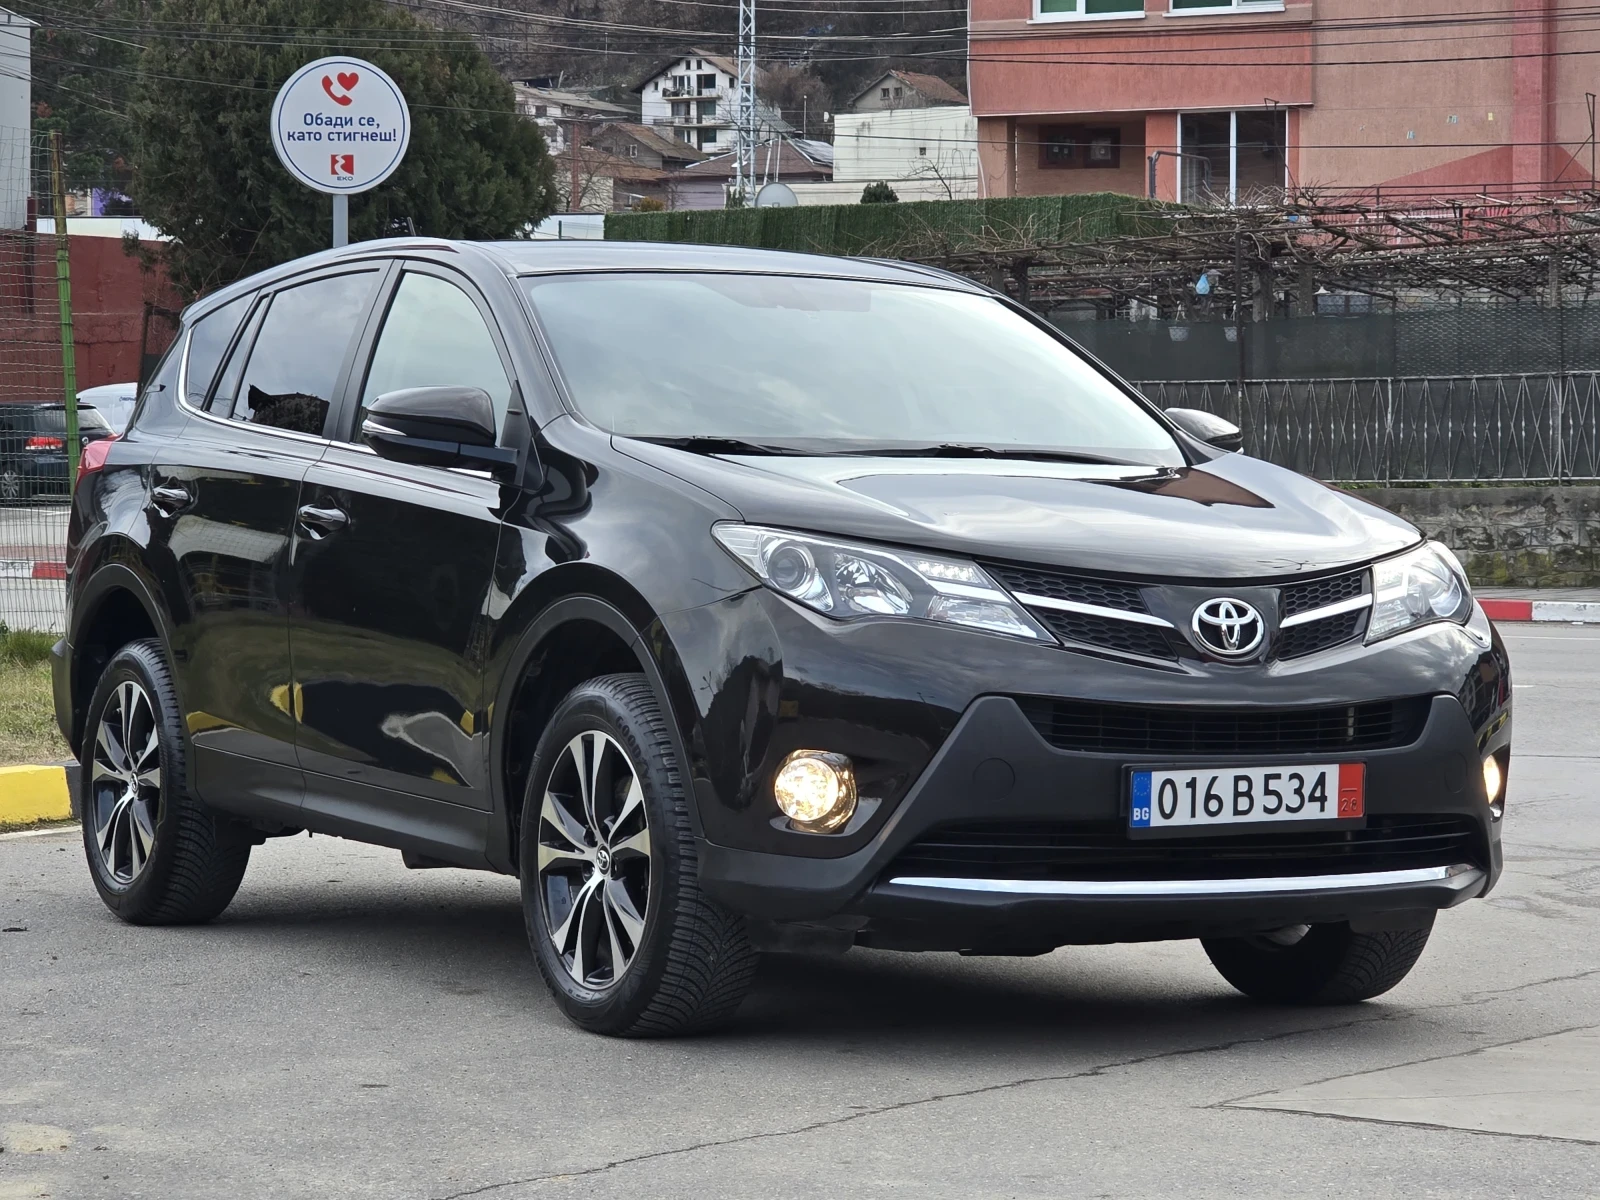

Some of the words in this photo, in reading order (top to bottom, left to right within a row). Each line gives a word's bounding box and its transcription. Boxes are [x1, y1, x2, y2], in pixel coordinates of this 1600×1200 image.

[303, 112, 353, 128] Обади
[358, 116, 380, 129] се,
[287, 131, 322, 141] като
[327, 128, 397, 141] стигнеш!
[1133, 807, 1150, 821] BG
[1157, 771, 1328, 820] 016B534
